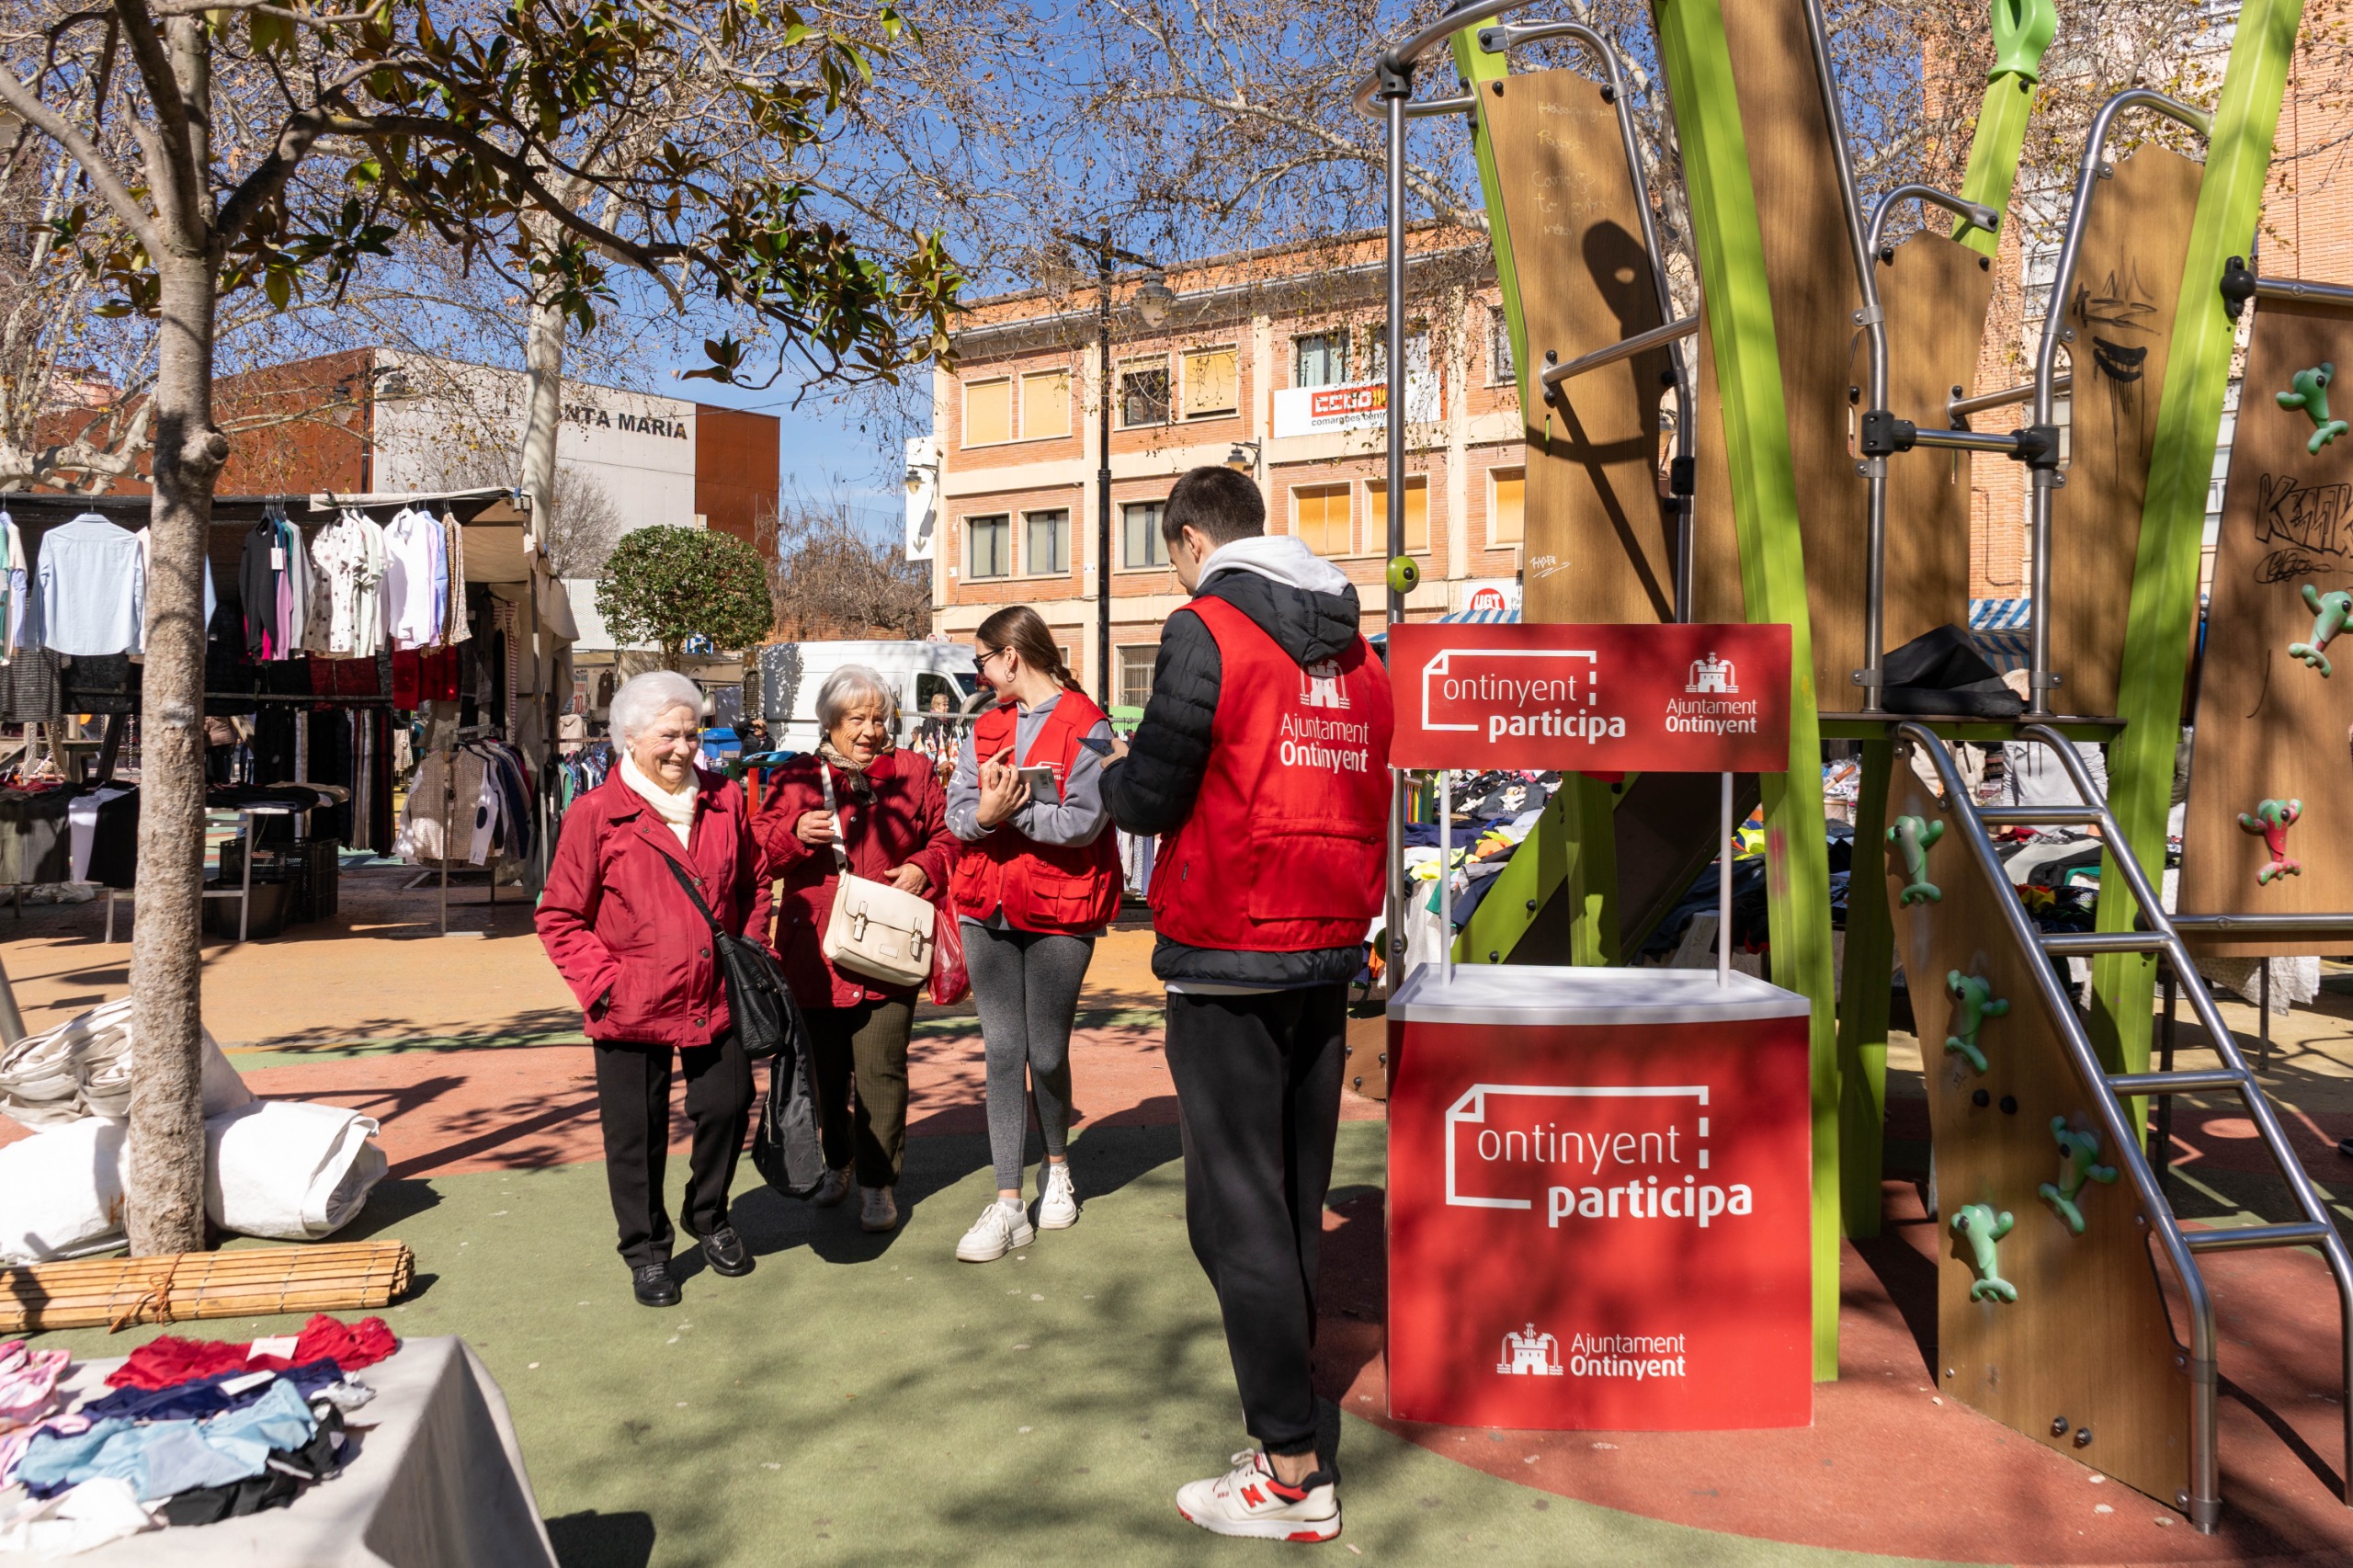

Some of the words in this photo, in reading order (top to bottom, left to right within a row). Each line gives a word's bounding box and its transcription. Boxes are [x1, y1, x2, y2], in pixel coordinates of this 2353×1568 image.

[559, 404, 611, 428] NTA
[618, 413, 688, 440] MARIA
[1473, 594, 1502, 611] UGT
[1443, 673, 1578, 709] ontinyent
[1665, 698, 1758, 718] Ajuntament
[1280, 712, 1370, 744] Ajuntament
[1489, 708, 1626, 744] participa
[1665, 714, 1757, 736] Ontinyent
[1279, 740, 1369, 775] Ontinyent
[1477, 1122, 1681, 1176] ontinyent
[1548, 1174, 1753, 1229] participa
[1571, 1332, 1687, 1358] Ajuntament
[1570, 1354, 1687, 1381] Ontinyent
